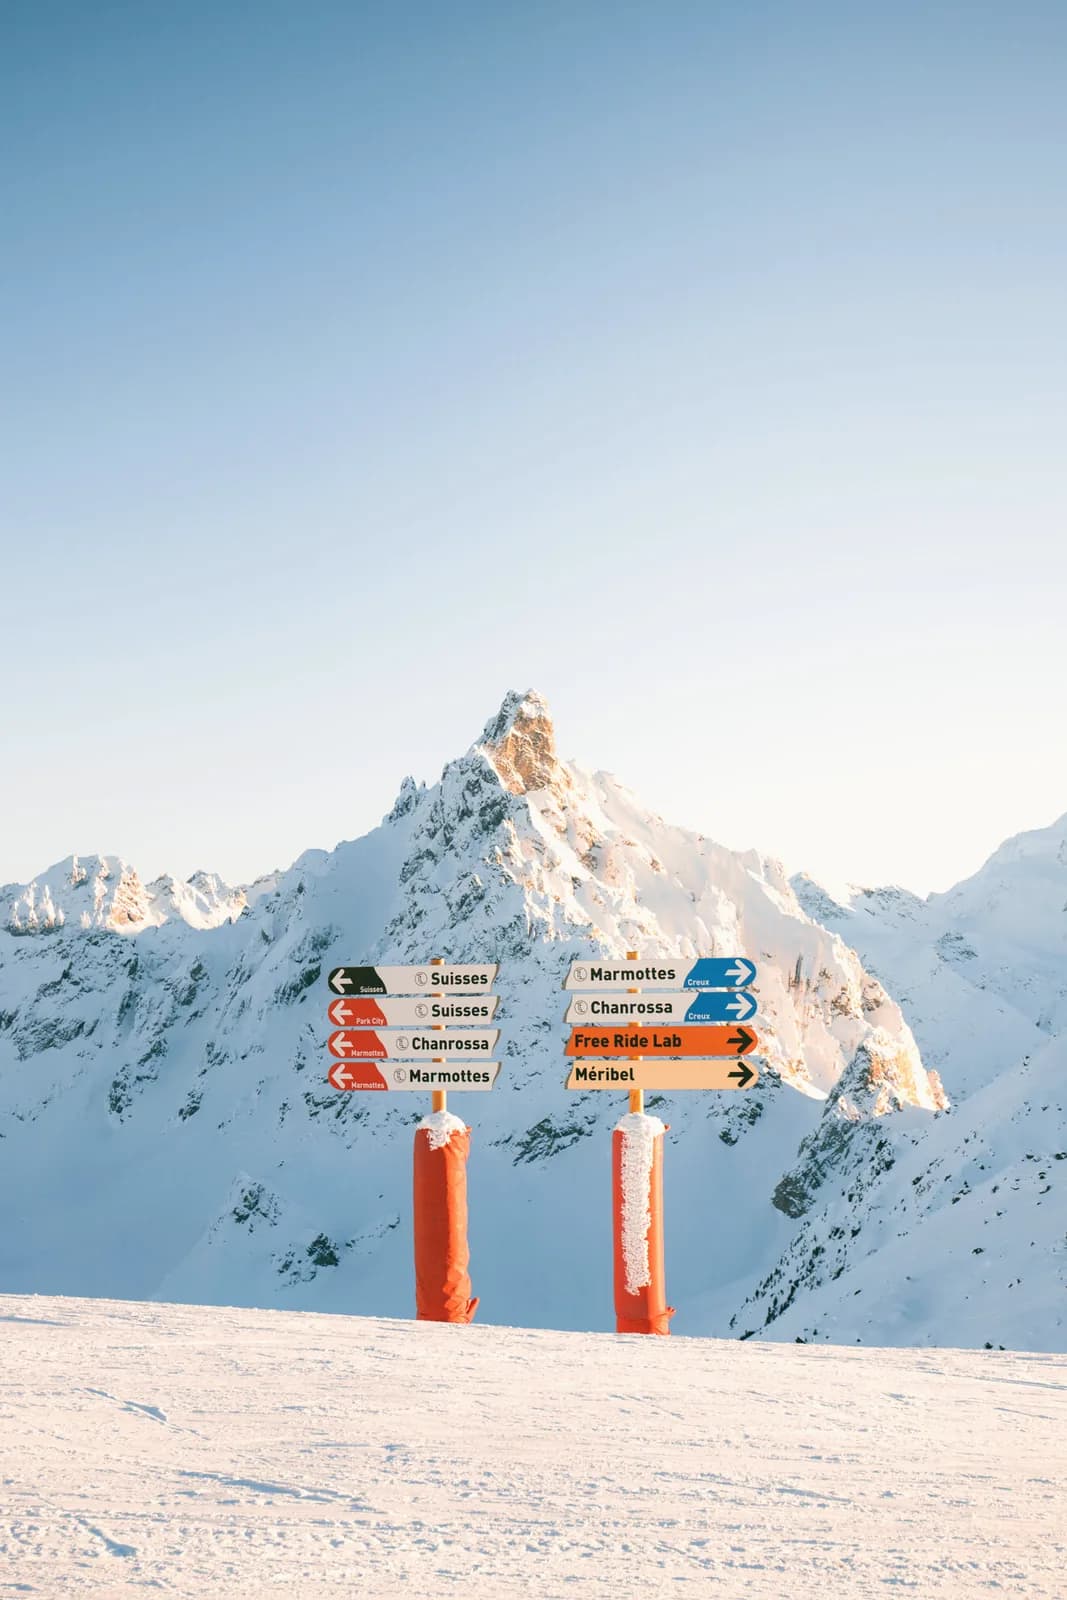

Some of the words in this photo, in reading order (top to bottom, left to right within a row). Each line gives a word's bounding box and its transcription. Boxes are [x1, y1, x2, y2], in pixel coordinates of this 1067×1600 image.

[431, 972, 488, 985] Suisses
[590, 968, 676, 981] Marmottes
[432, 1004, 488, 1017] Suisses
[591, 1001, 672, 1014] Chanrossa
[412, 1037, 488, 1050] Chanrossa
[575, 1035, 609, 1047] Free
[614, 1035, 648, 1047] Ride
[653, 1035, 681, 1047] Lab
[410, 1070, 489, 1082] Marmottes
[576, 1066, 634, 1081] Méribel
